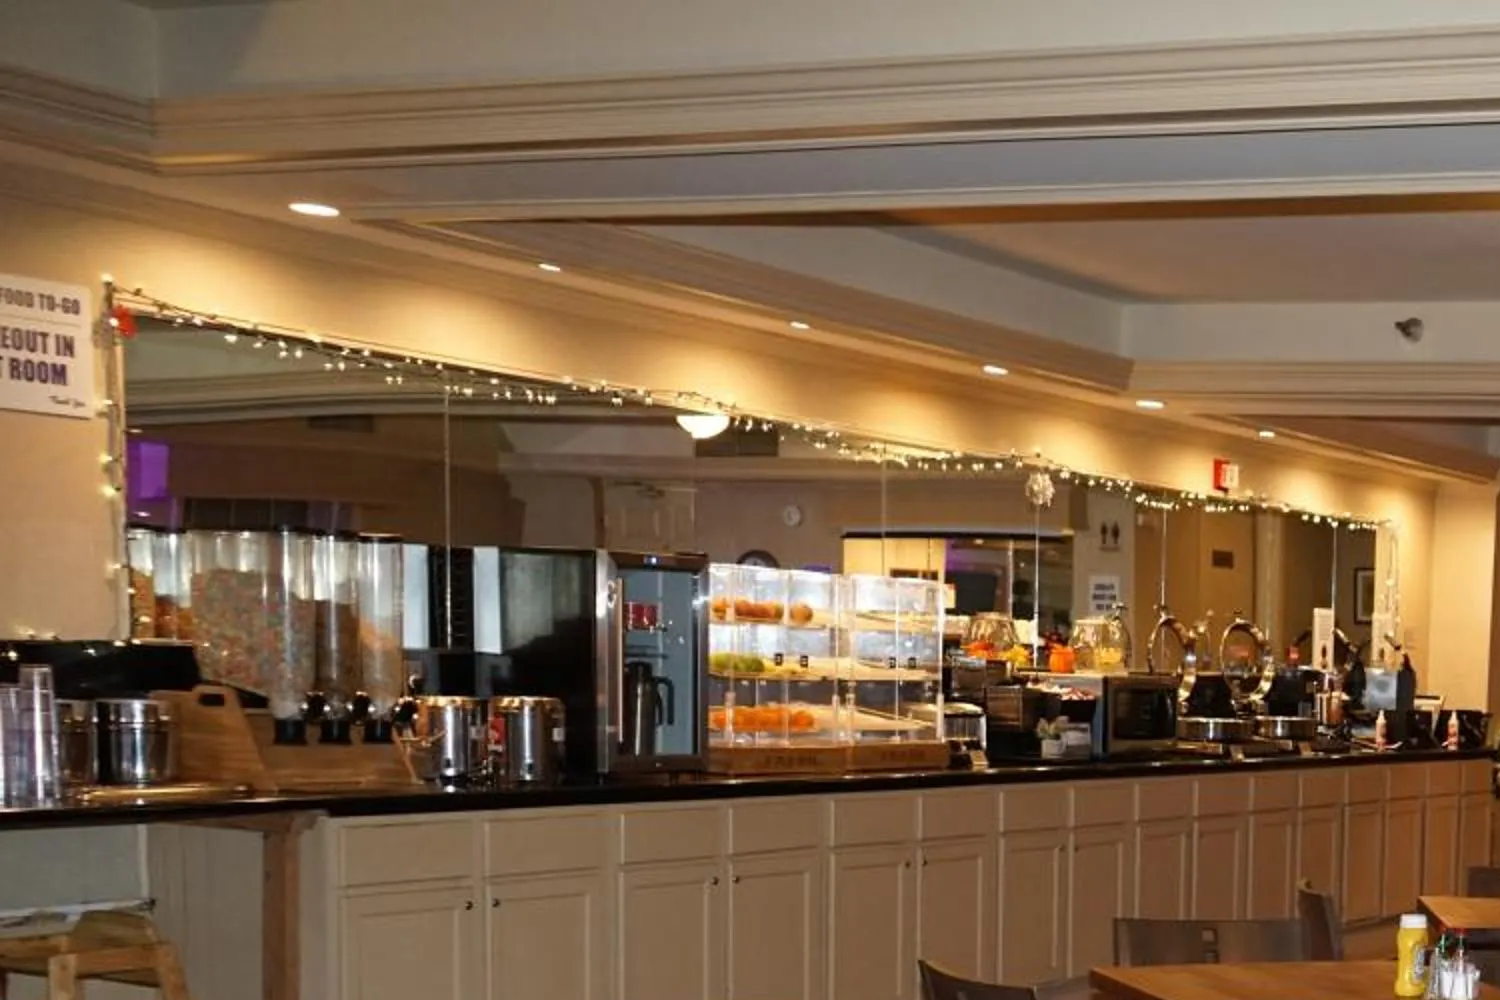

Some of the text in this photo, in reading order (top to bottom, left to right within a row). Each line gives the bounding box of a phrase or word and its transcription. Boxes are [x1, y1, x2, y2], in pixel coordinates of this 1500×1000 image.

[39, 292, 81, 316] TO-GO
[55, 333, 75, 358] IN
[10, 357, 67, 386] ROOM
